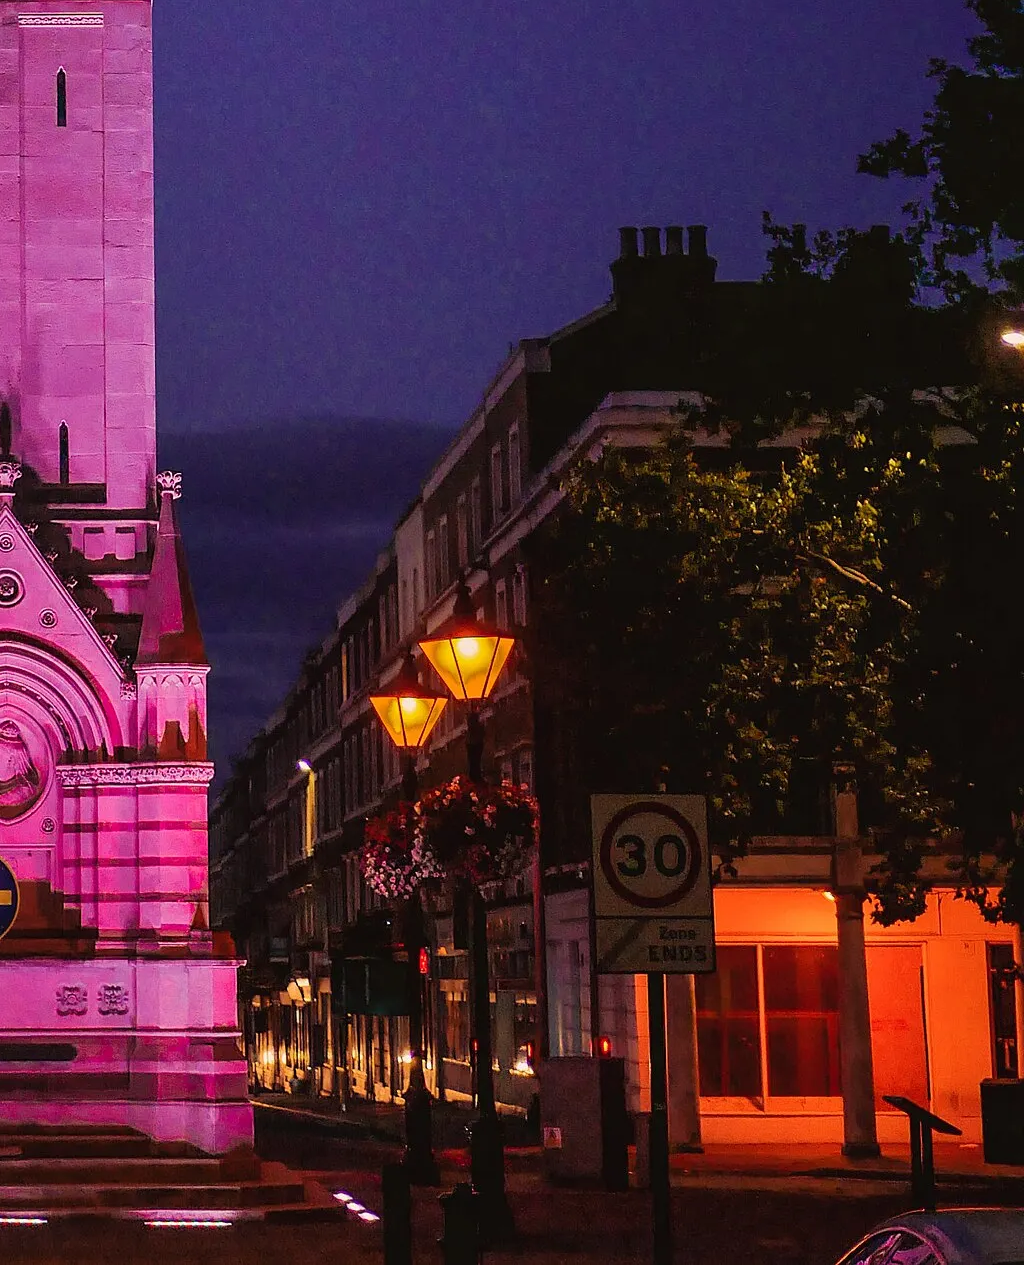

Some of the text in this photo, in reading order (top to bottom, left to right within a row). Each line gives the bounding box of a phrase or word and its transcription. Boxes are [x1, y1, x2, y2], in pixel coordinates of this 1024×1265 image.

[616, 835, 686, 877] 30
[659, 925, 696, 940] Zone
[649, 944, 707, 963] ENDS
